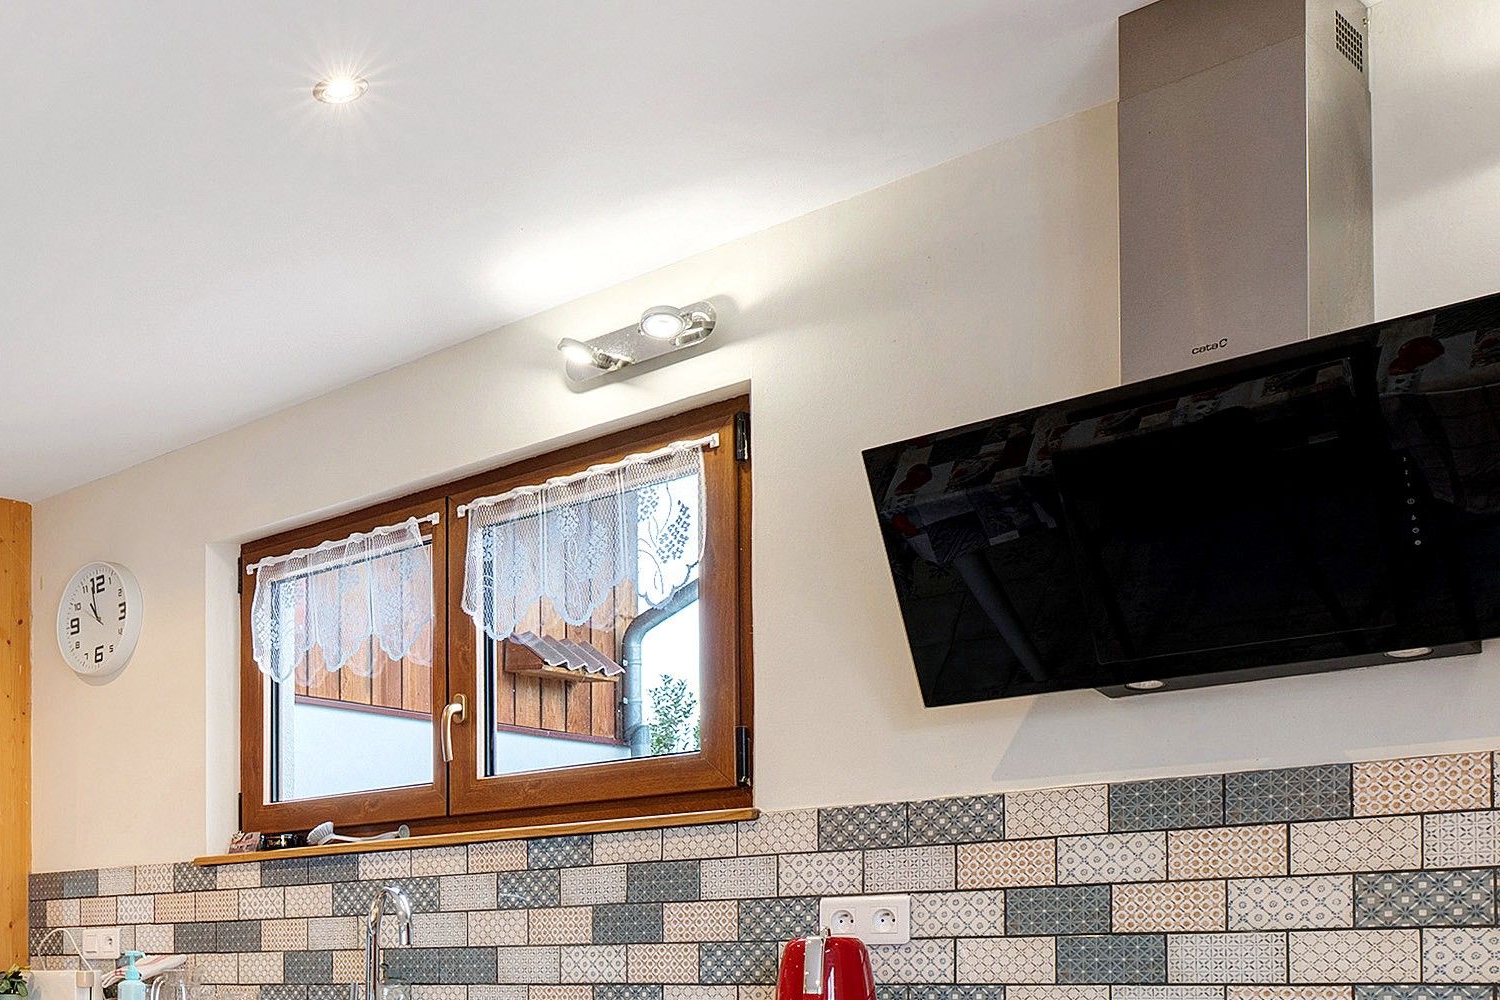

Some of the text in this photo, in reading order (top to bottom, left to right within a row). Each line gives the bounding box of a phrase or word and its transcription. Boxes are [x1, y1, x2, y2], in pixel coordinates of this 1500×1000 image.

[90, 574, 105, 594] 12
[108, 577, 111, 585] 1
[82, 585, 89, 593] 11
[74, 602, 82, 611] 10
[118, 601, 126, 621] 3
[70, 617, 80, 635] 9
[75, 641, 80, 649] 8
[109, 644, 114, 653] 5
[94, 645, 104, 663] 6
